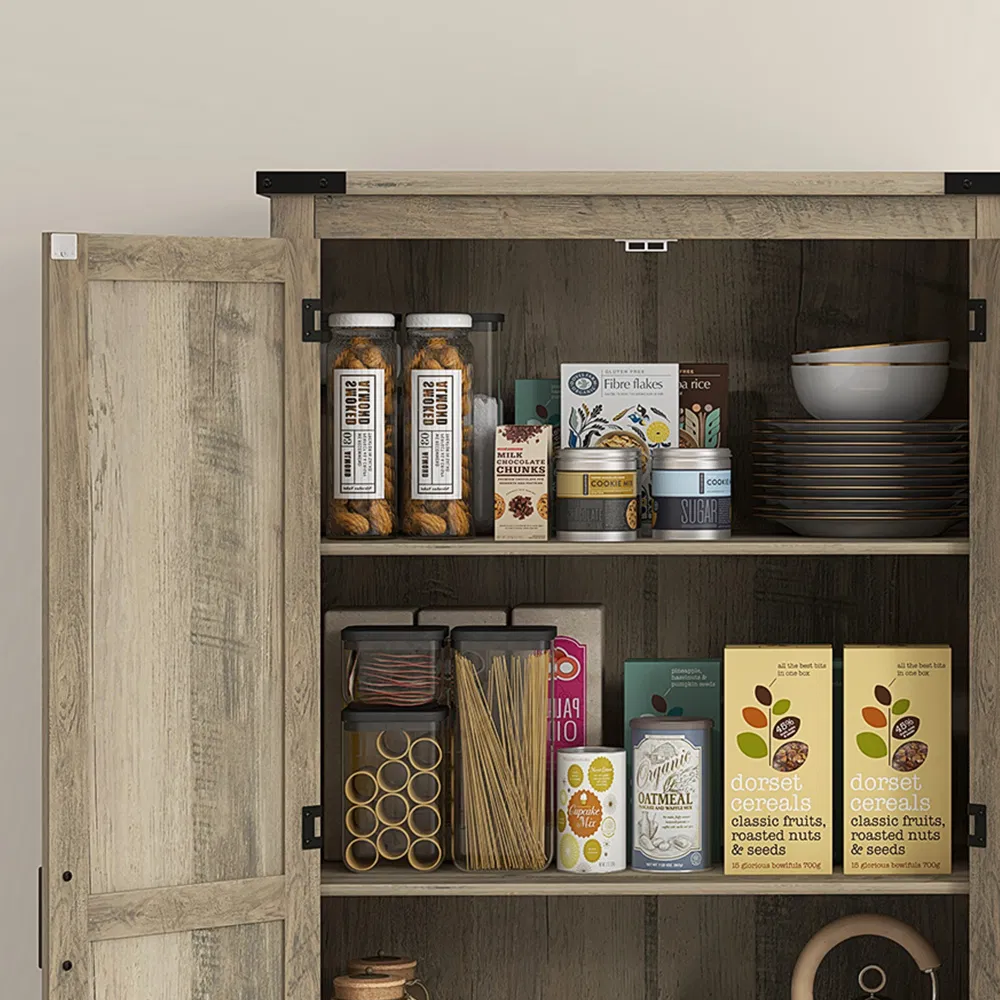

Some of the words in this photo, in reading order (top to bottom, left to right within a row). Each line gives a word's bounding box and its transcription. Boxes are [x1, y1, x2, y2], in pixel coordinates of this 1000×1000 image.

[604, 378, 631, 389] Fibre
[633, 378, 663, 389] flakes
[691, 378, 711, 389] rice
[496, 466, 546, 474] CHUNKS
[680, 498, 718, 524] SUGAR
[636, 749, 691, 790] Organic
[731, 774, 802, 791] dorset
[850, 773, 922, 791] dorset
[638, 791, 693, 806] OATMEAL
[731, 794, 811, 812] cereals
[850, 794, 931, 811] cereals
[568, 804, 600, 818] Cupcake
[578, 816, 597, 828] Mix
[731, 815, 779, 827] classic
[783, 815, 826, 828] fruits,
[850, 814, 898, 826] classic
[902, 814, 945, 828] fruits,
[732, 830, 784, 841] roasted
[789, 830, 821, 841] nuts
[851, 829, 904, 841] roasted
[908, 830, 940, 841] nuts
[731, 844, 743, 855] &
[747, 844, 786, 855] seeds
[850, 843, 863, 855] &
[866, 844, 905, 855] seeds
[741, 862, 770, 870] glorious
[803, 862, 821, 870] 700g
[861, 862, 889, 870] glorious
